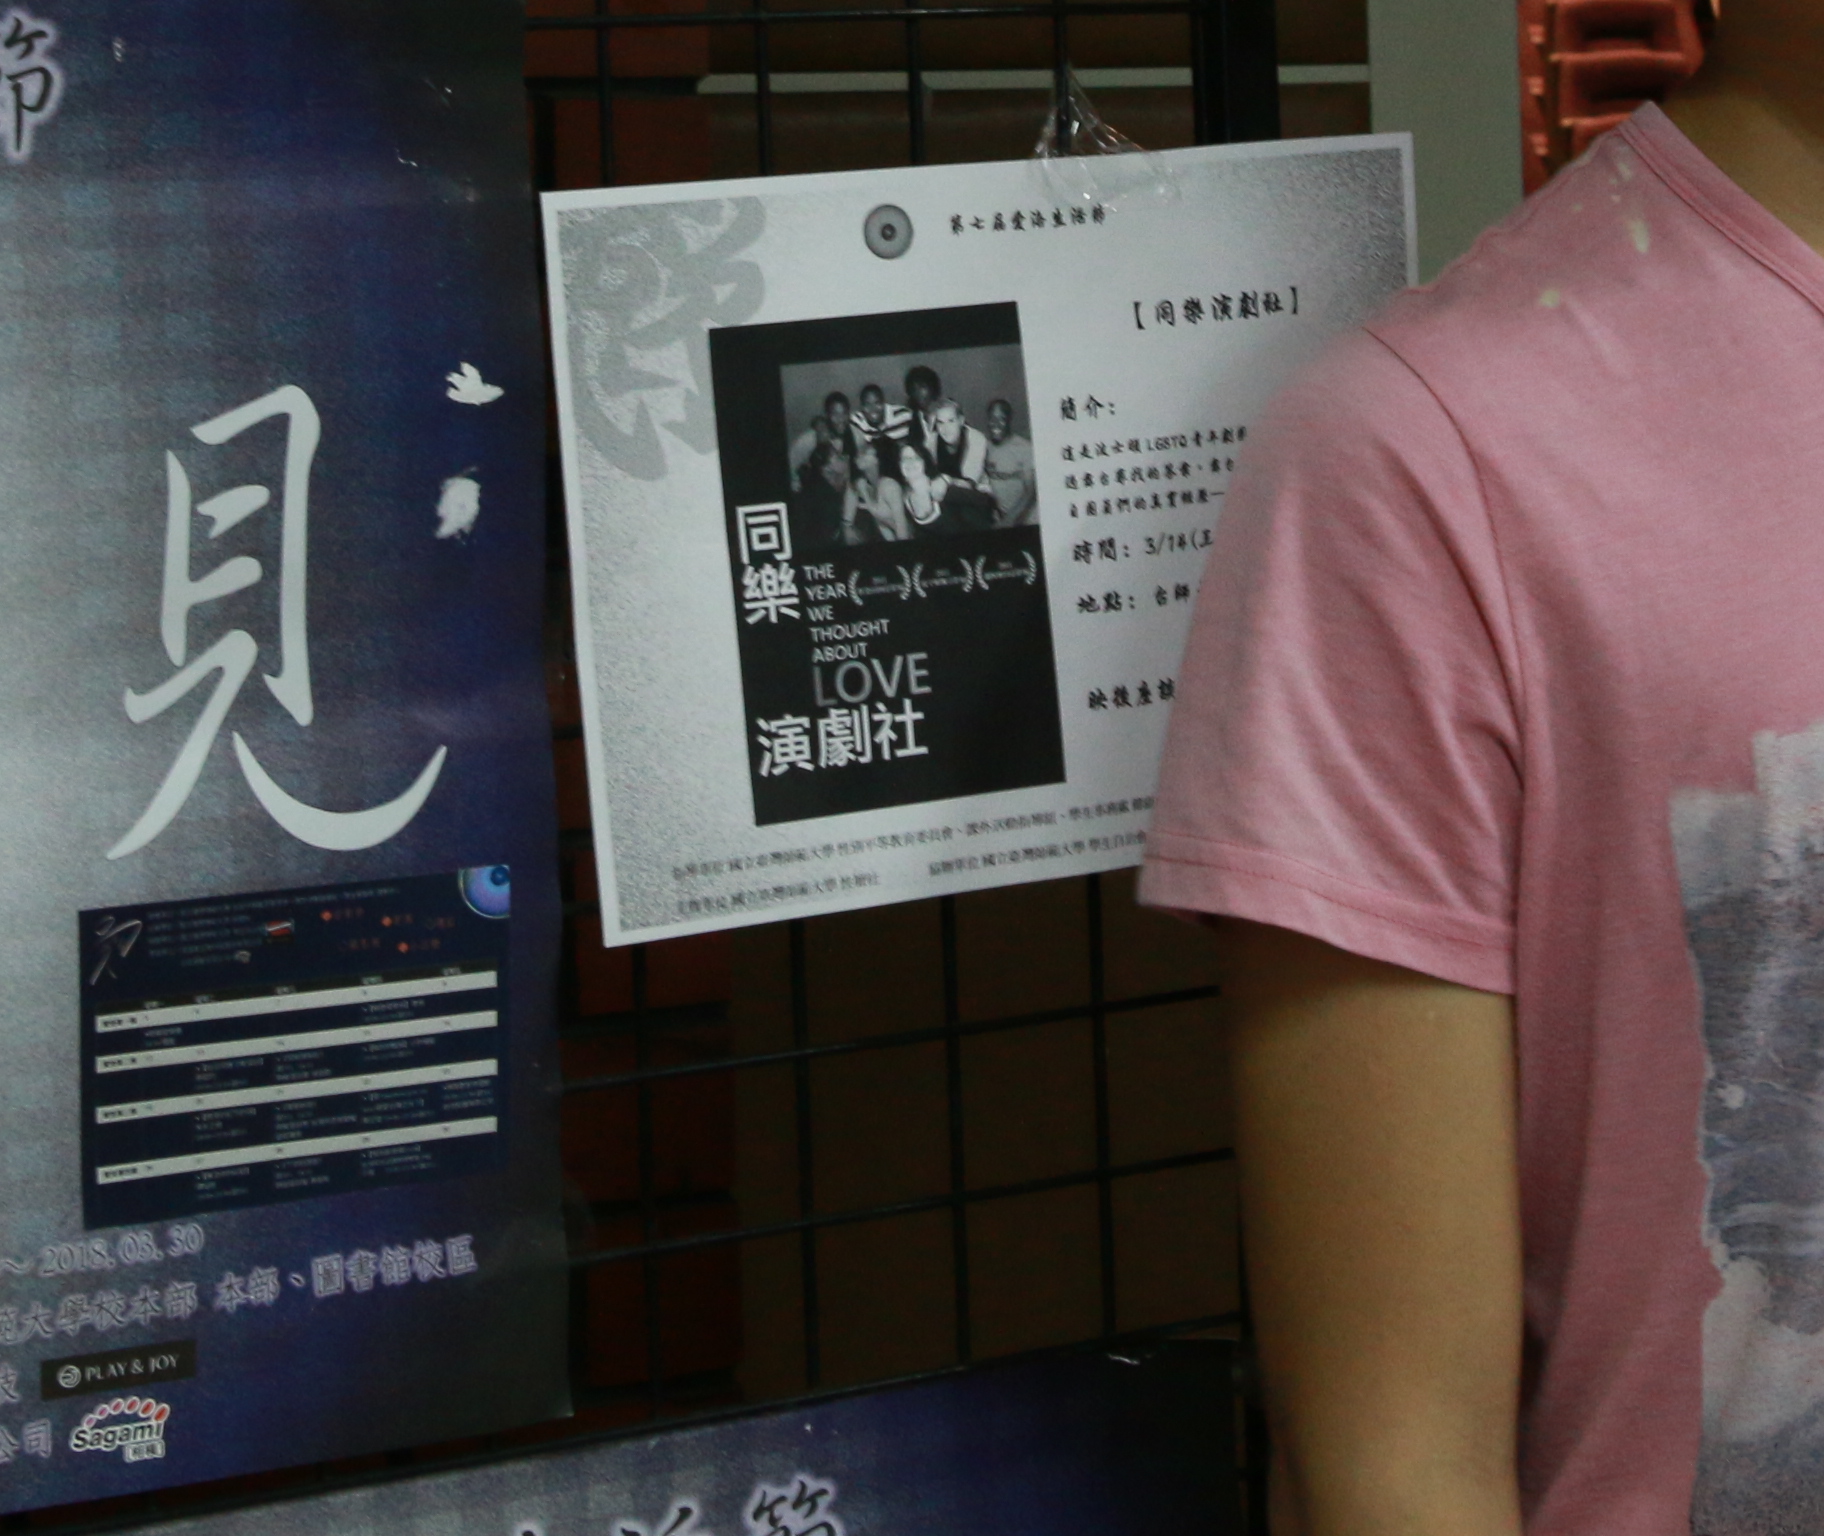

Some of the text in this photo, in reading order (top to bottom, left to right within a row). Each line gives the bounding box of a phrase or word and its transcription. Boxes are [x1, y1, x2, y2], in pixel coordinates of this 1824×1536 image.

[804, 563, 835, 582] THE
[805, 582, 848, 602] YEAR
[106, 384, 447, 860] 見
[807, 605, 834, 622] WE
[810, 618, 891, 644] THOUGHT
[811, 642, 869, 664] ABOUT
[814, 652, 932, 707] LOVE
[755, 699, 929, 777] 演劇社
[72, 1421, 164, 1451] Sagami
